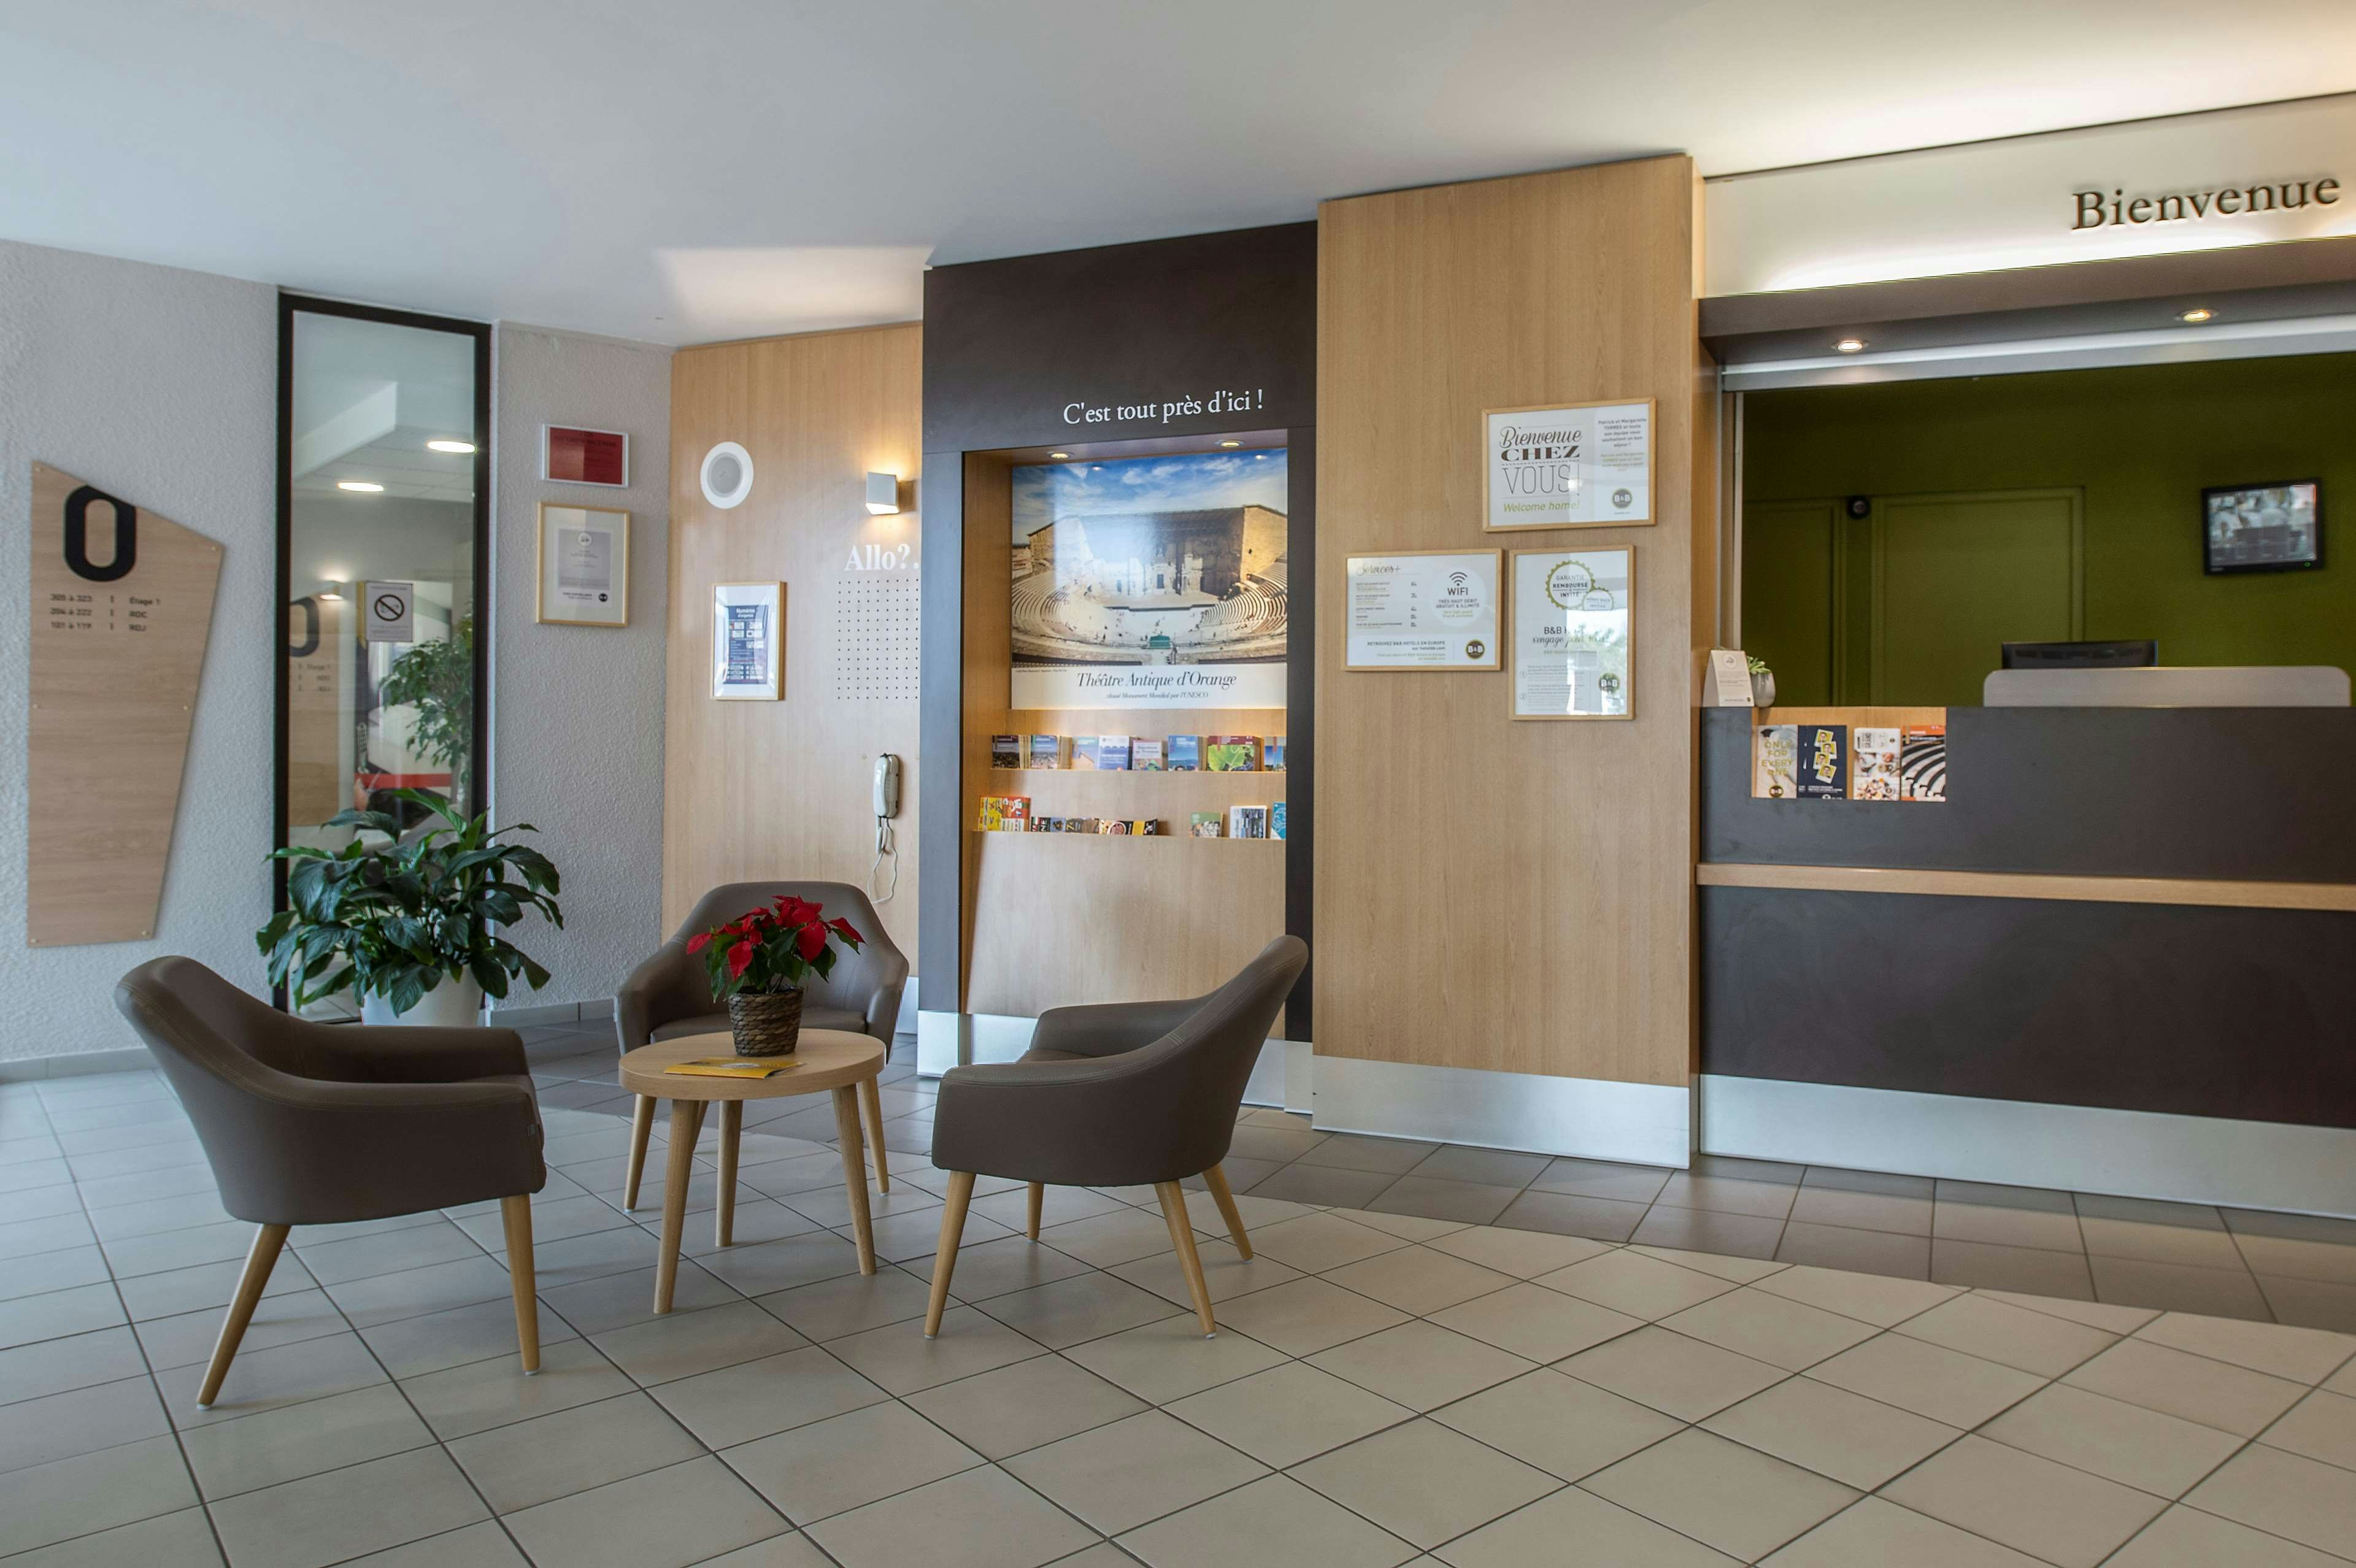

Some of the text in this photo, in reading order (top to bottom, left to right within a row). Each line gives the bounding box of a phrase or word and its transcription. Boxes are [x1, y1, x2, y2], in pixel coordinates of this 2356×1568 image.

[2070, 177, 2341, 231] Bienvenue
[1063, 402, 1111, 425] C'est
[1117, 403, 1157, 421] tout
[1161, 395, 1202, 423] près
[1207, 391, 1250, 413] d'ici
[1499, 426, 1582, 449] Bienvenue
[1501, 445, 1580, 461] CHEZ
[1503, 503, 1546, 513] Welcome
[1447, 587, 1468, 596] WIFI
[1544, 626, 1562, 634] B&B
[1077, 671, 1237, 691] Théâtre Antique d'Orange
[1761, 758, 1793, 767] EVERY
